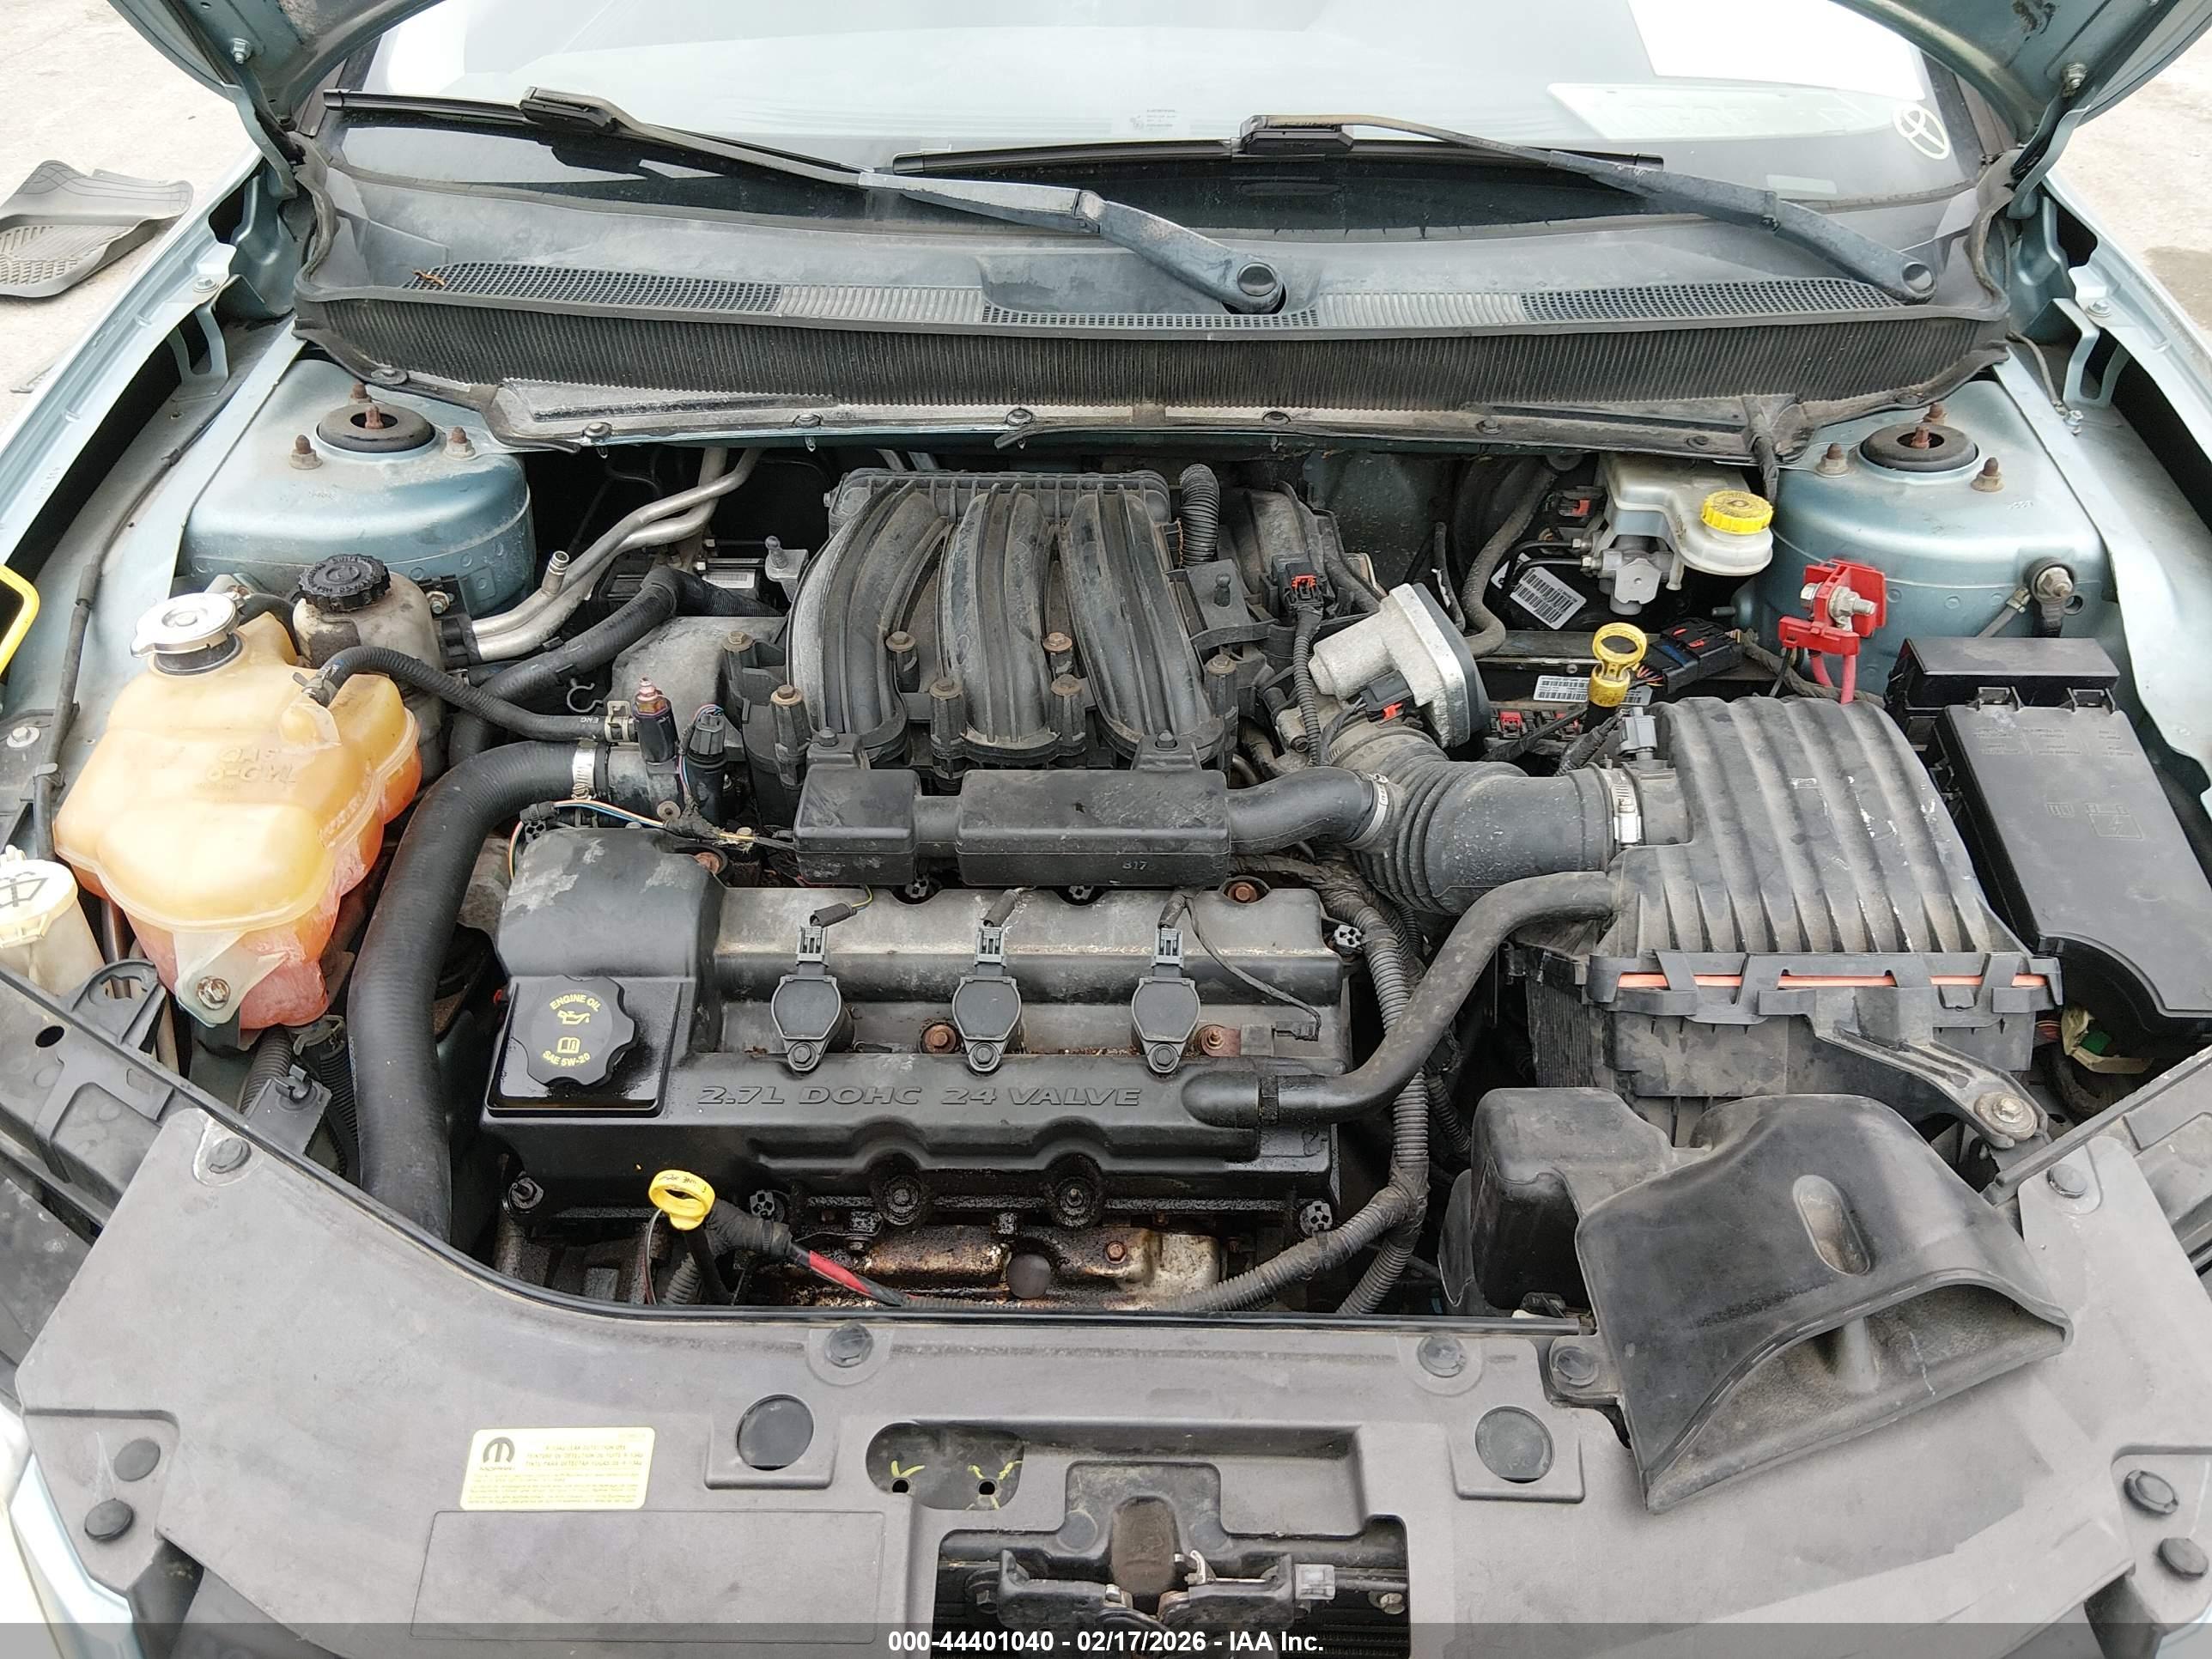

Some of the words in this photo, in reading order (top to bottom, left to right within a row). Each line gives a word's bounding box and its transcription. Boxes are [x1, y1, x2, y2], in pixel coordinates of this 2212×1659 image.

[550, 994, 587, 1011] ENGINE
[586, 998, 602, 1012] OIL
[543, 1050, 562, 1066] SAE
[561, 1053, 591, 1066] 5W-20
[696, 1085, 785, 1105] 2.7L
[798, 1086, 922, 1106] DOHC
[941, 1087, 997, 1106] 24
[1008, 1087, 1142, 1107] VALVE
